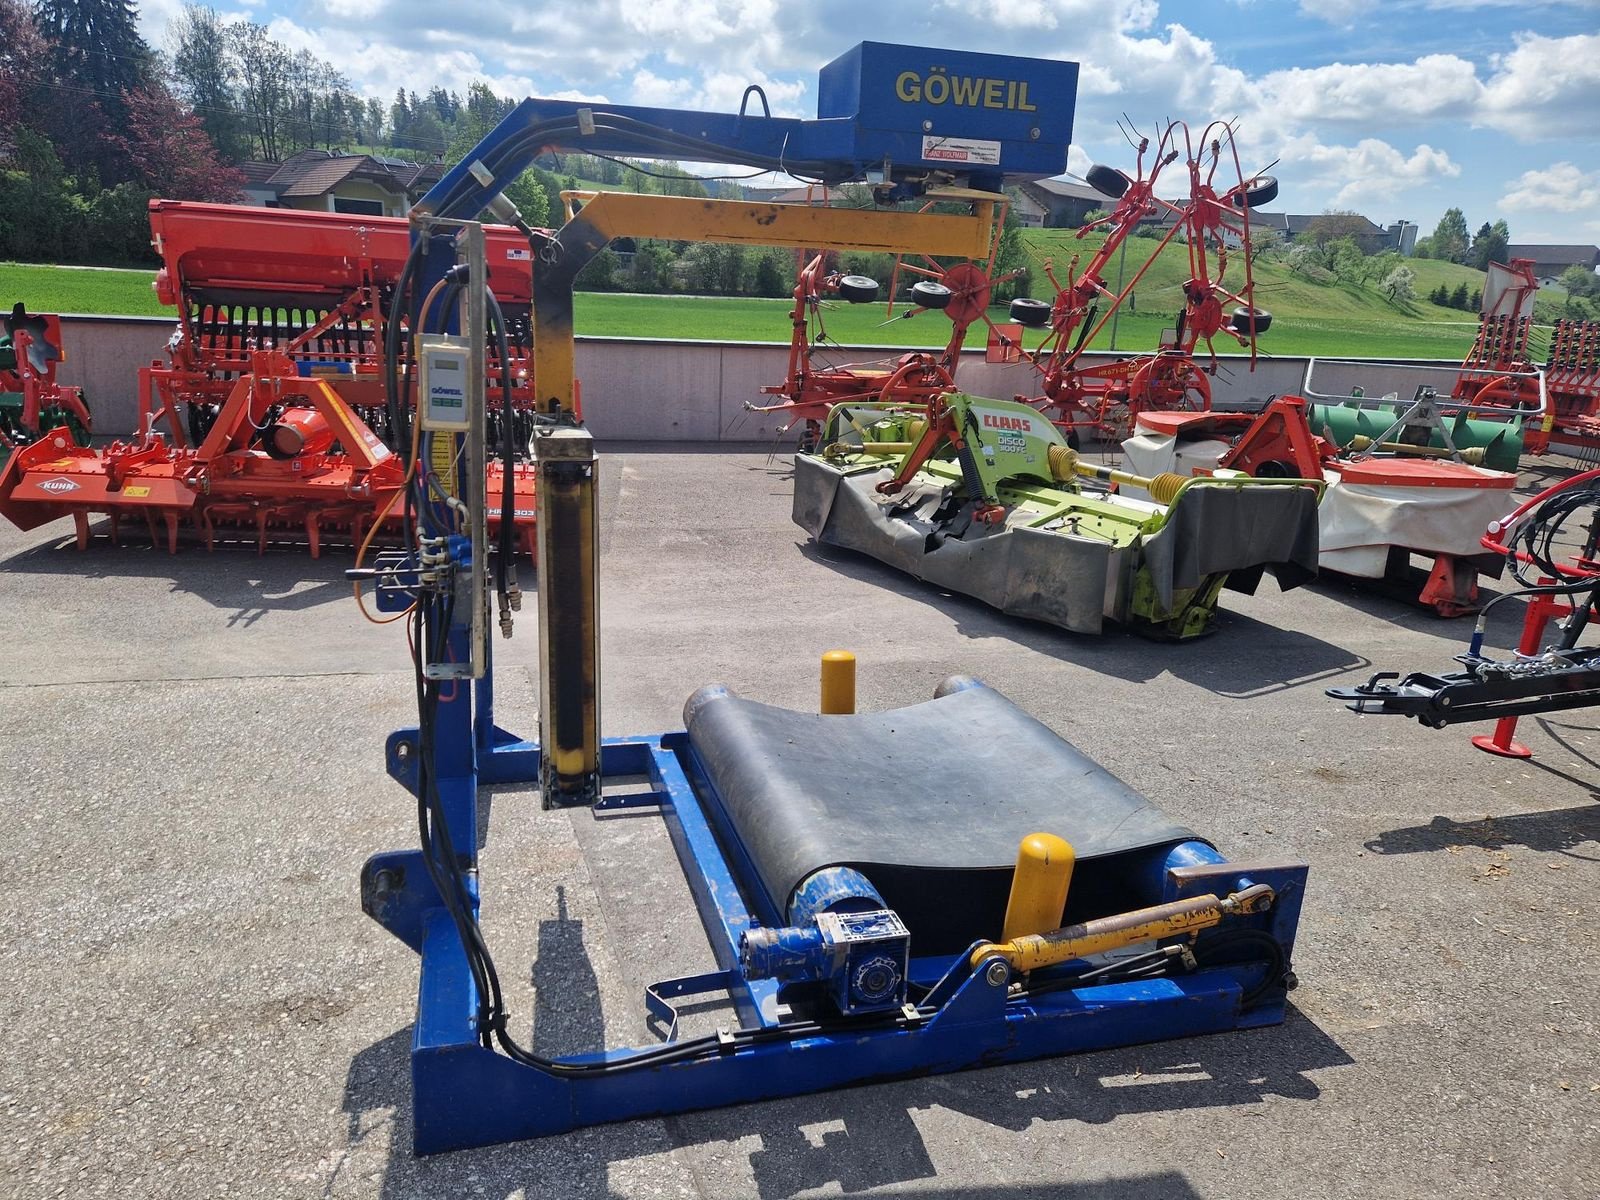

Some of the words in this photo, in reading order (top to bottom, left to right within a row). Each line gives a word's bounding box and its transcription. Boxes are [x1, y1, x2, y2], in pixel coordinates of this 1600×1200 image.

[896, 66, 1036, 111] GÖWEIL
[431, 386, 463, 395] GÖWEIL
[983, 414, 1031, 432] CLAAS
[998, 436, 1026, 447] DISCO
[43, 482, 74, 490] KUHN
